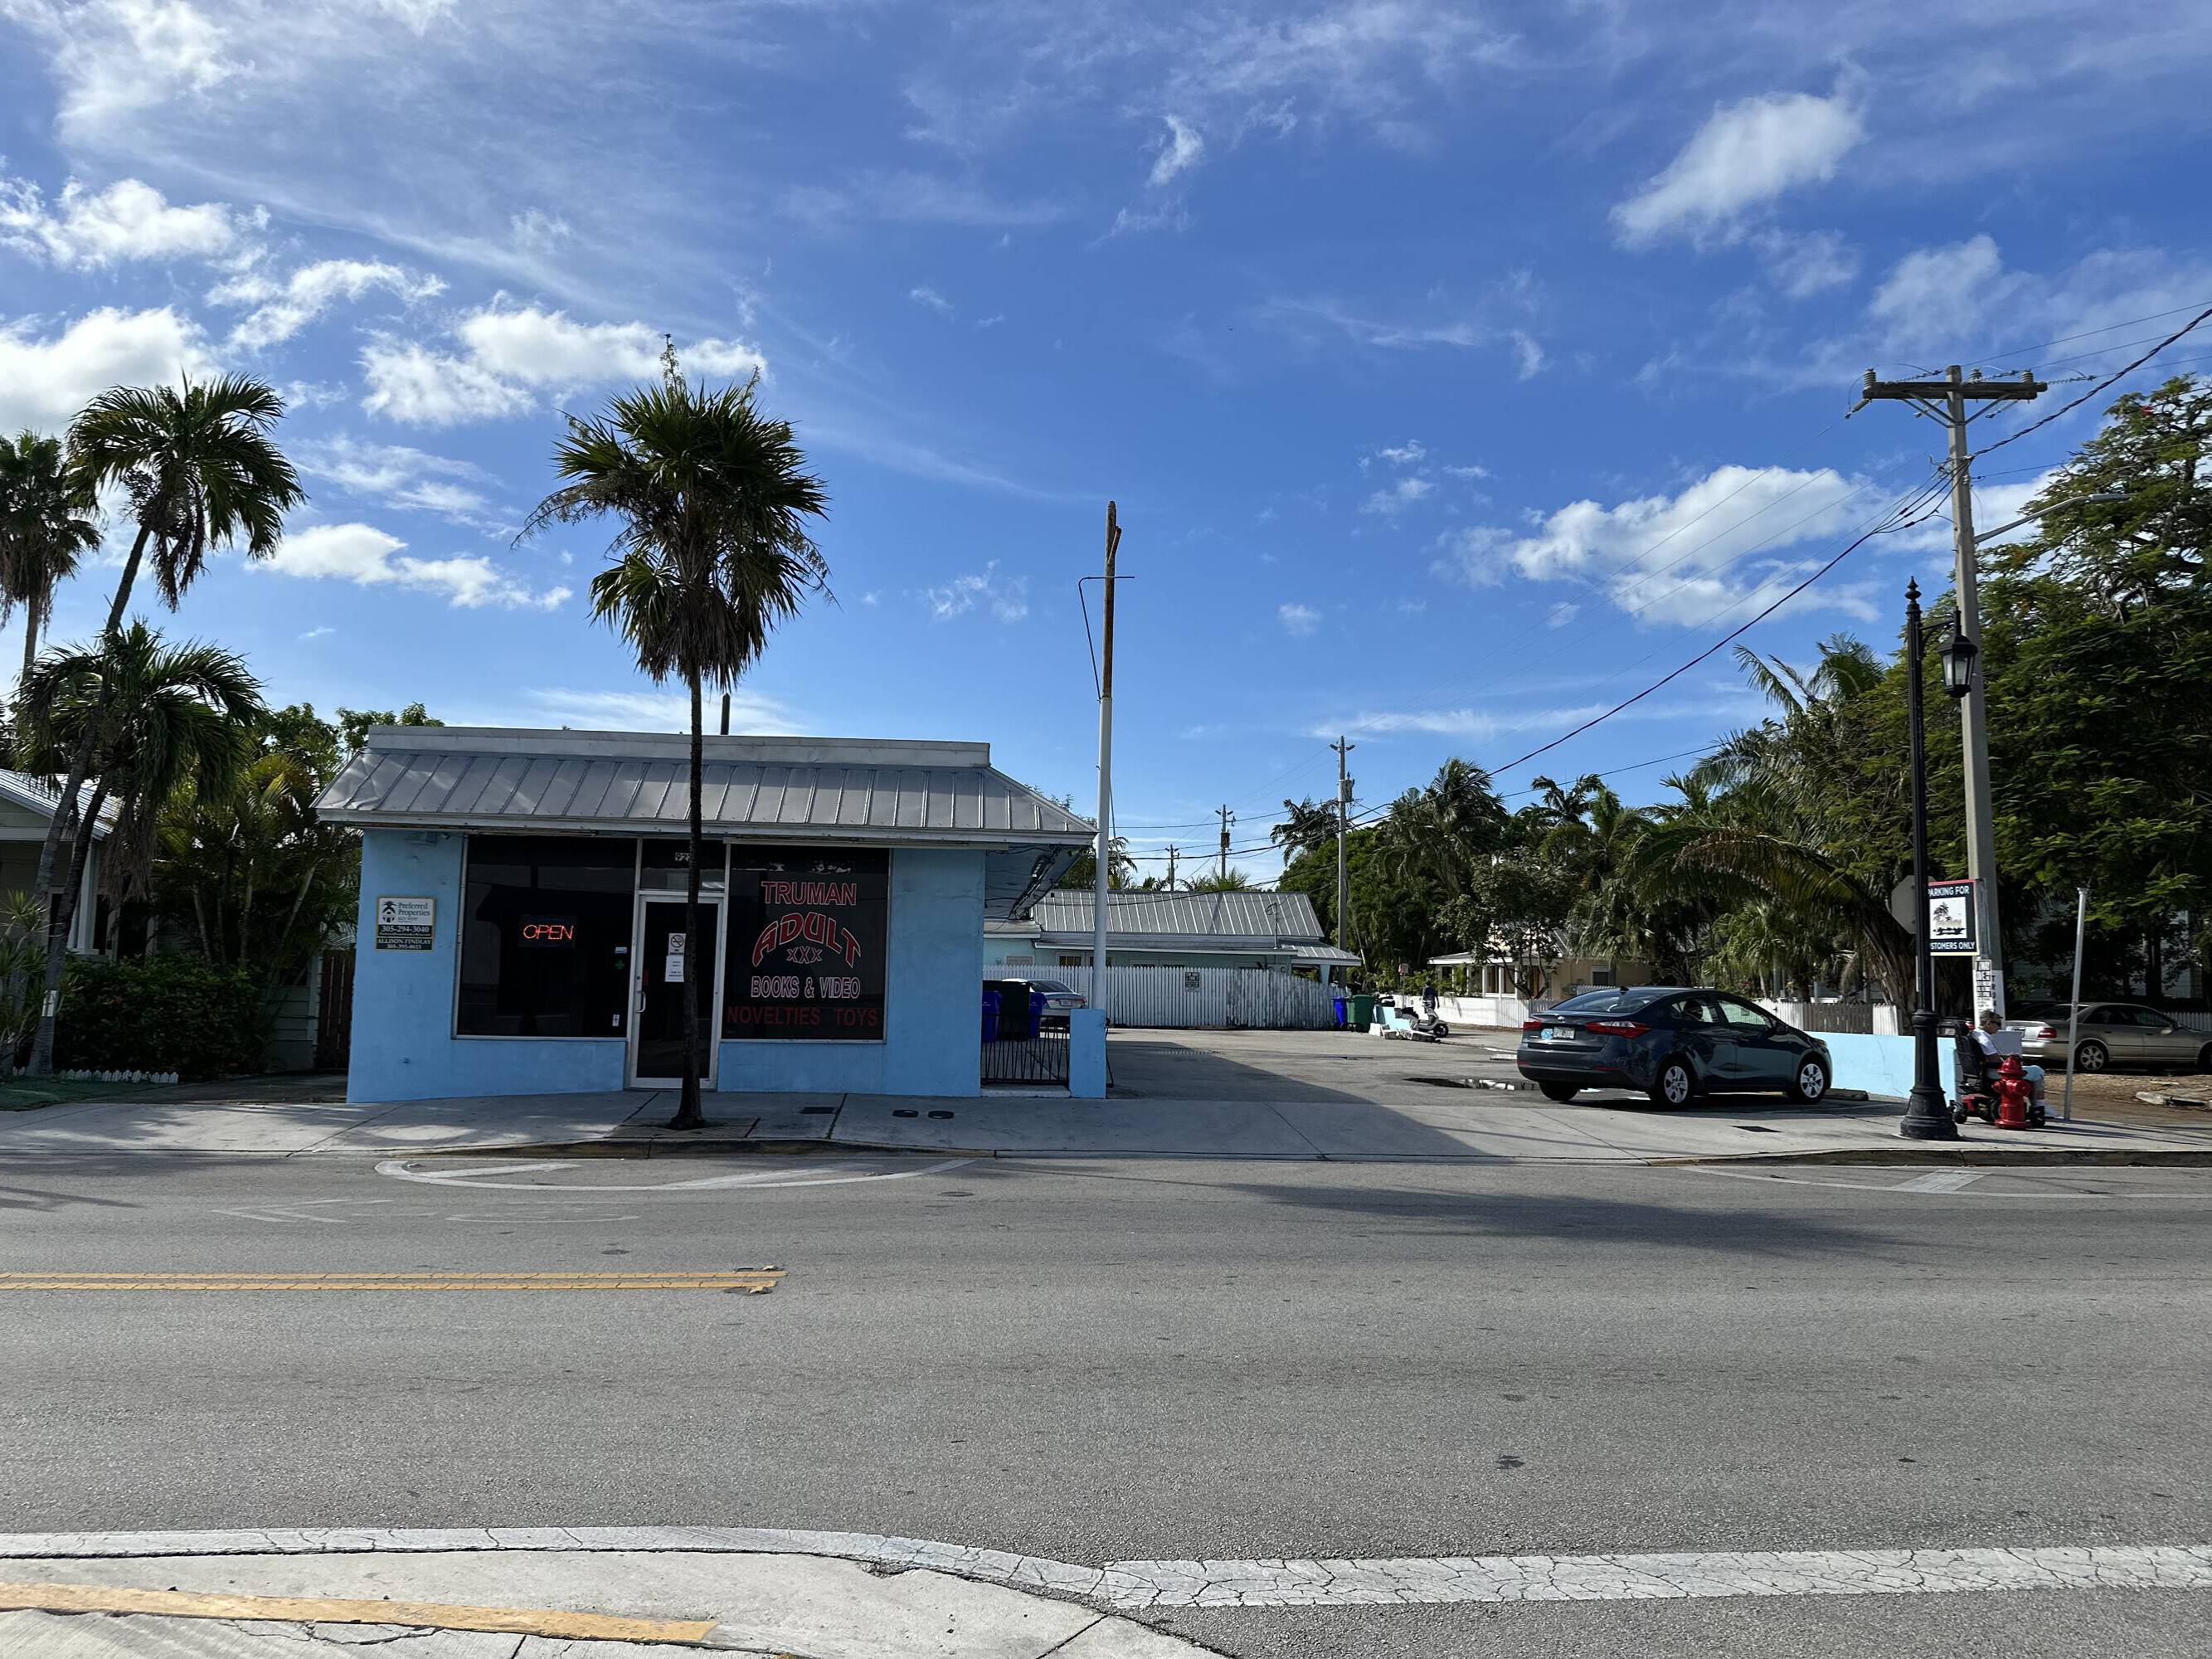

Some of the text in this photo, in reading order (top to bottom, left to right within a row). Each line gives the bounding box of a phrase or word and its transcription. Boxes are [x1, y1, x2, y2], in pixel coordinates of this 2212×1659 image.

[761, 881, 858, 907] TRUMAN
[1955, 885, 1970, 895] FOR
[523, 924, 574, 940] OPEN
[751, 911, 863, 969] ADULT
[786, 945, 824, 965] XXX
[1930, 941, 1976, 951] STOMERS ONLY
[750, 975, 862, 1000] BOOKS & VIDEO
[726, 1006, 879, 1028] NOVELTIES TOYS
